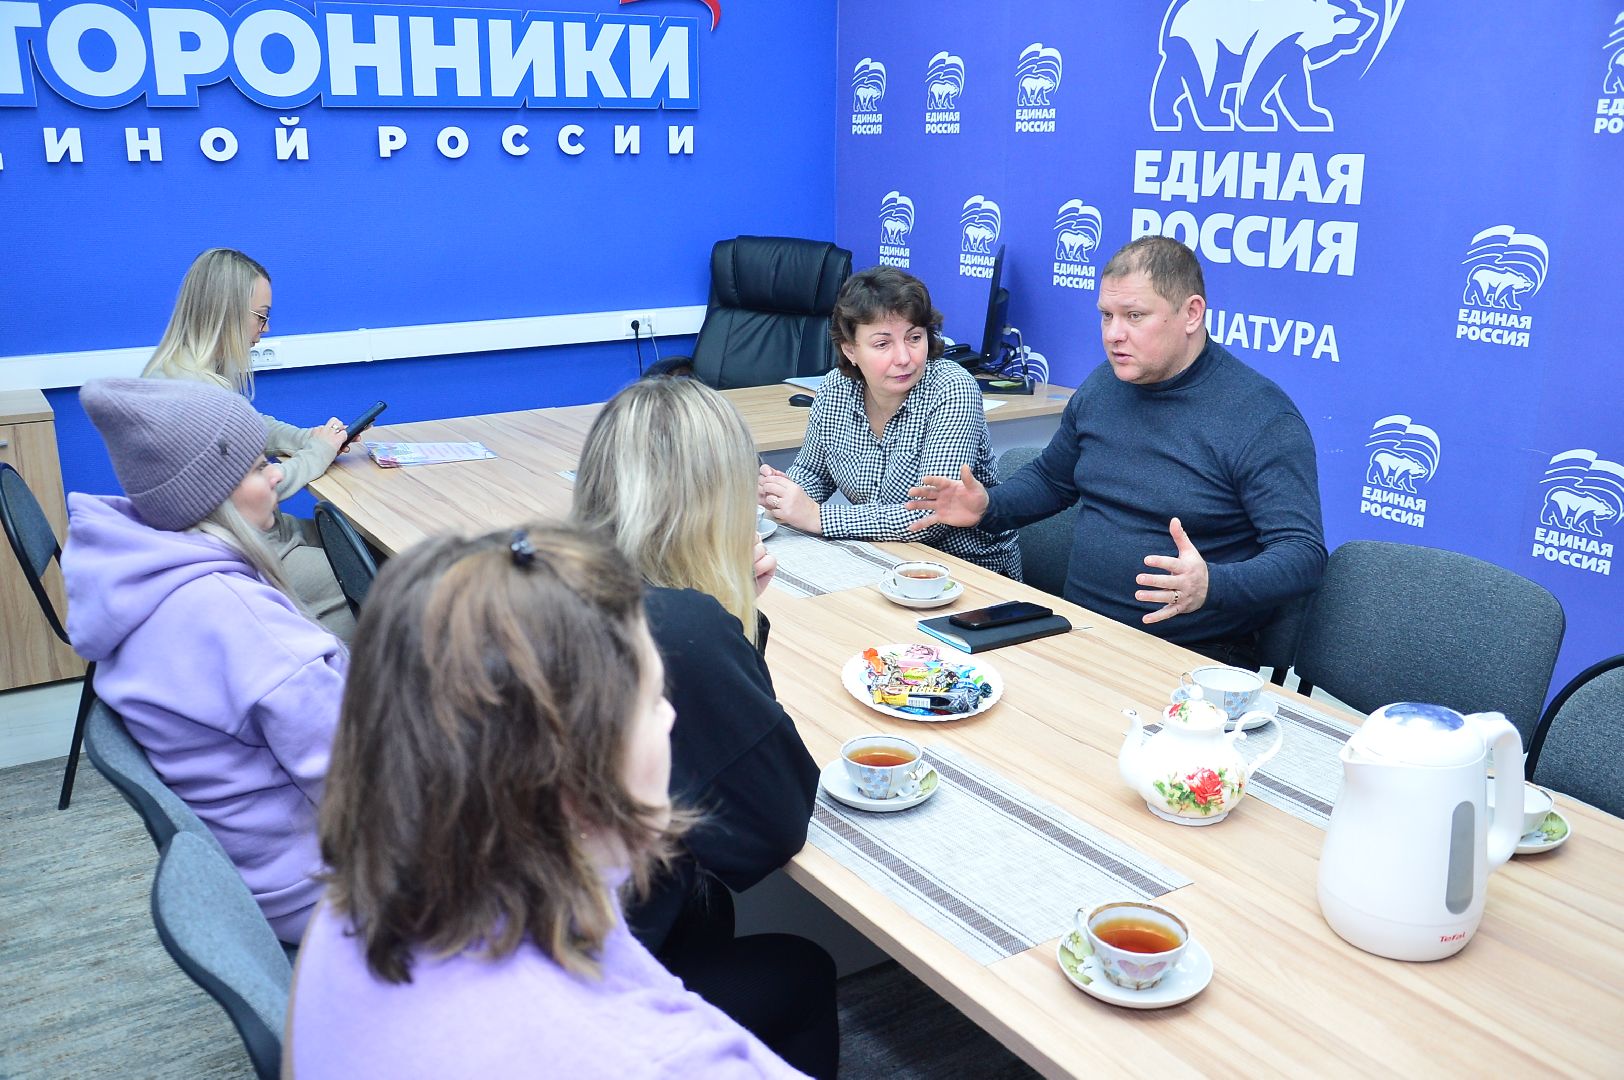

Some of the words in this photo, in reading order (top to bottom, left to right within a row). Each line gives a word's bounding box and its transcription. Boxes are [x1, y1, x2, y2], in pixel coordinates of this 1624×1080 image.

[852, 114, 882, 123] ЕДИНАЯ
[926, 111, 960, 122] ЕДИНАЯ
[1016, 108, 1056, 120] ЕДИНАЯ
[852, 124, 882, 134] РОССИЯ
[925, 123, 960, 134] РОССИЯ
[1015, 120, 1056, 133] РОССИЯ
[1594, 117, 1624, 134] РО
[0, 117, 309, 170] ИНОЙ
[379, 125, 694, 158] РОССИИ
[1134, 150, 1365, 205] ЕДИНАЯ
[1131, 208, 1359, 276] РОССИЯ
[879, 246, 910, 257] ЕДИНАЯ
[879, 256, 910, 268] РОССИЯ
[960, 254, 995, 266] ЕДИНАЯ
[959, 265, 994, 279] РОССИЯ
[1053, 262, 1096, 277] ЕДИНАЯ
[1053, 276, 1095, 290] РОССИЯ
[1458, 308, 1532, 329] ЕДИНАЯ
[1456, 325, 1530, 348] РОССИЯ
[1361, 485, 1427, 512] ЕДИНАЯ
[1360, 500, 1425, 528] РОССИЯ
[1534, 527, 1614, 558] ЕДИНАЯ
[1532, 543, 1611, 575] РОССИЯ
